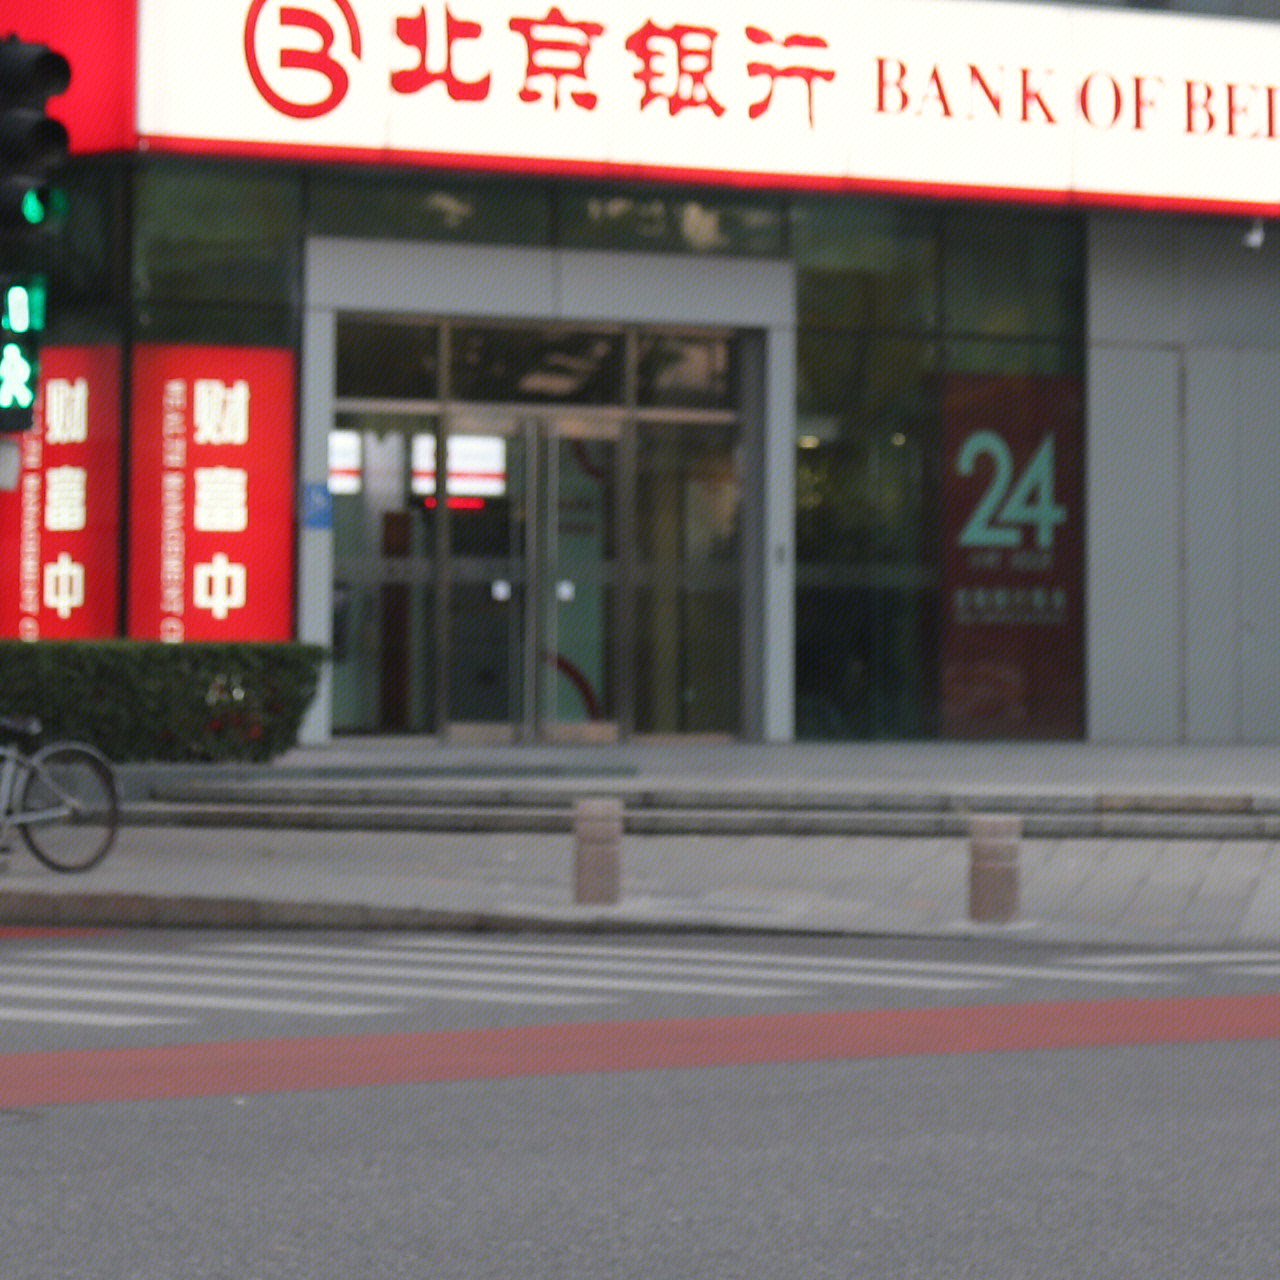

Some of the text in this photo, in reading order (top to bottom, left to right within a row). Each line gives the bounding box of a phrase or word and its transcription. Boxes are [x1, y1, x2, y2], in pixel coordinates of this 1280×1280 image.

[390, 2, 835, 129] 北京银行
[874, 56, 1058, 125] BANK
[1078, 71, 1164, 131] OF
[956, 429, 1067, 549] 24
